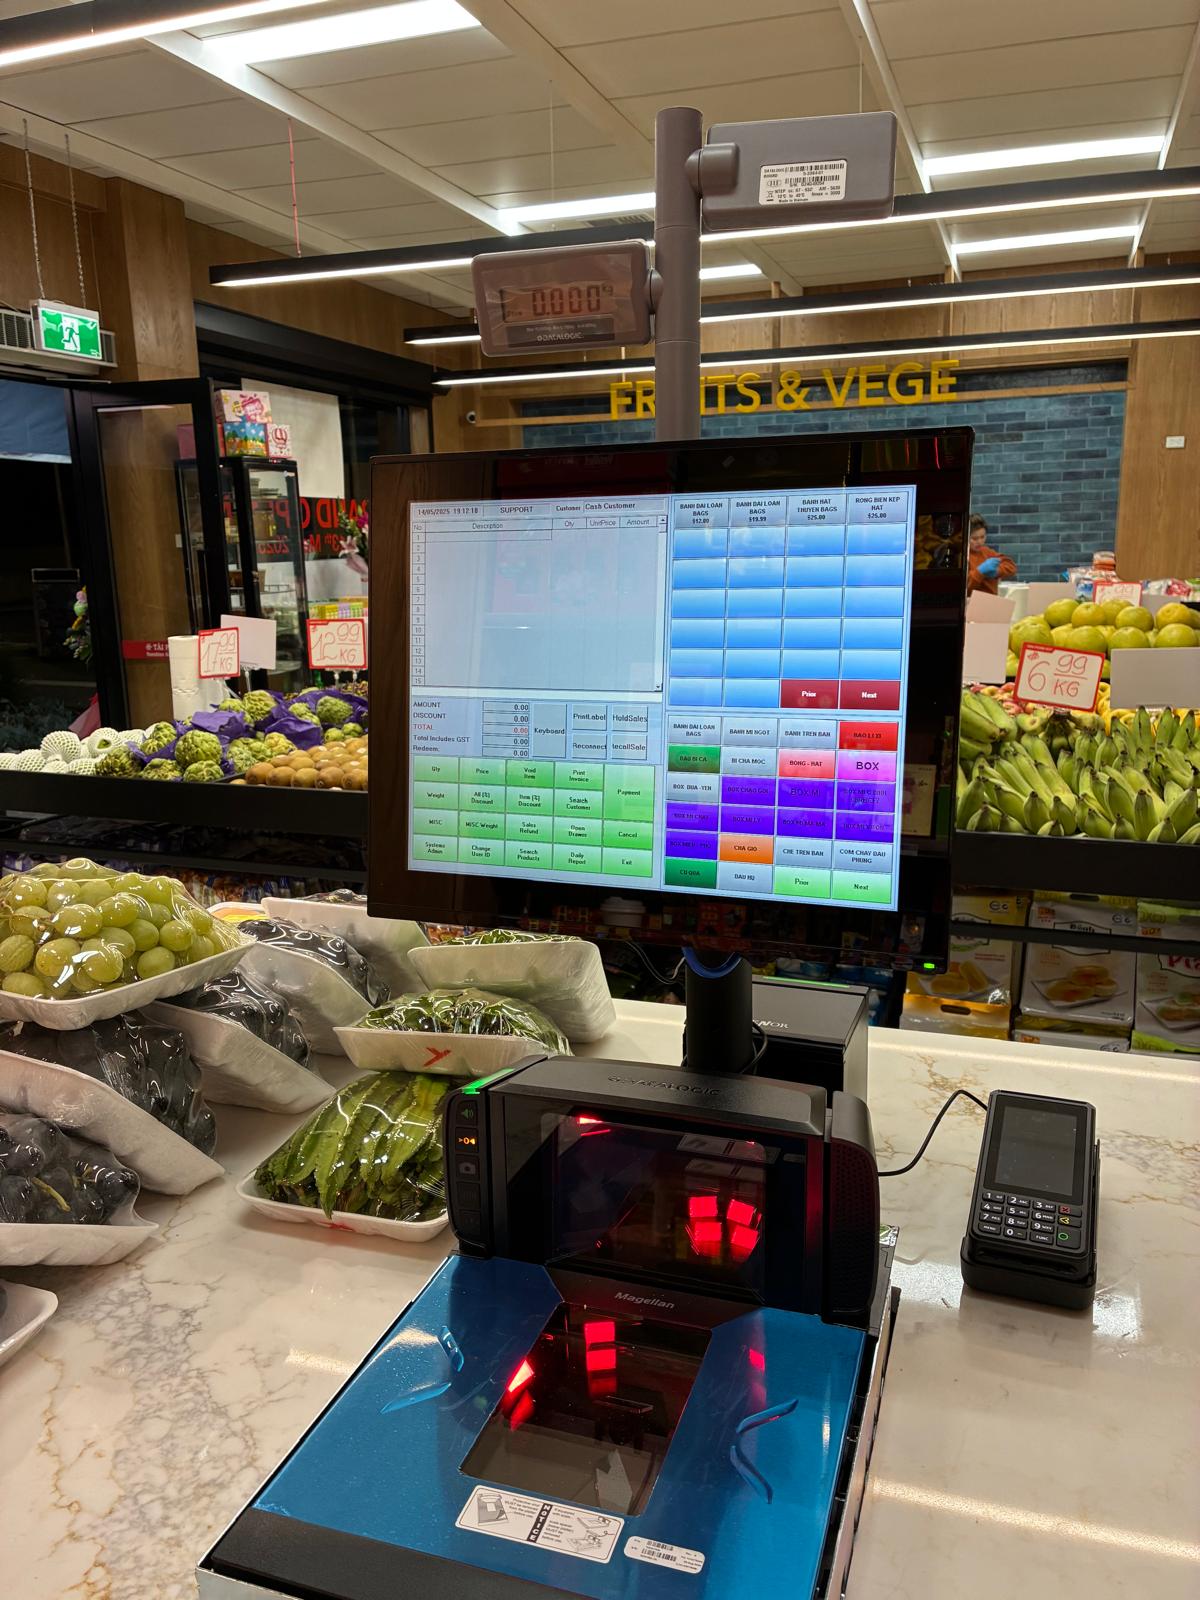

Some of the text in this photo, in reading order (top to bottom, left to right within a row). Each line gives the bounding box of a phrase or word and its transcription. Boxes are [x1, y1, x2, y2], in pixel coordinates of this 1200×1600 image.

[532, 285, 601, 316] 0.000
[610, 359, 959, 420] FRITS & VEGE
[312, 623, 360, 661] 12 99
[219, 657, 233, 672] KG
[340, 649, 356, 663] KG
[1028, 654, 1088, 691] 6 99
[1053, 679, 1080, 698] KG
[534, 727, 565, 735] Keyboard
[856, 761, 879, 771] BOX
[614, 1292, 675, 1308] Magellan
[530, 1504, 550, 1541] NOTICE
